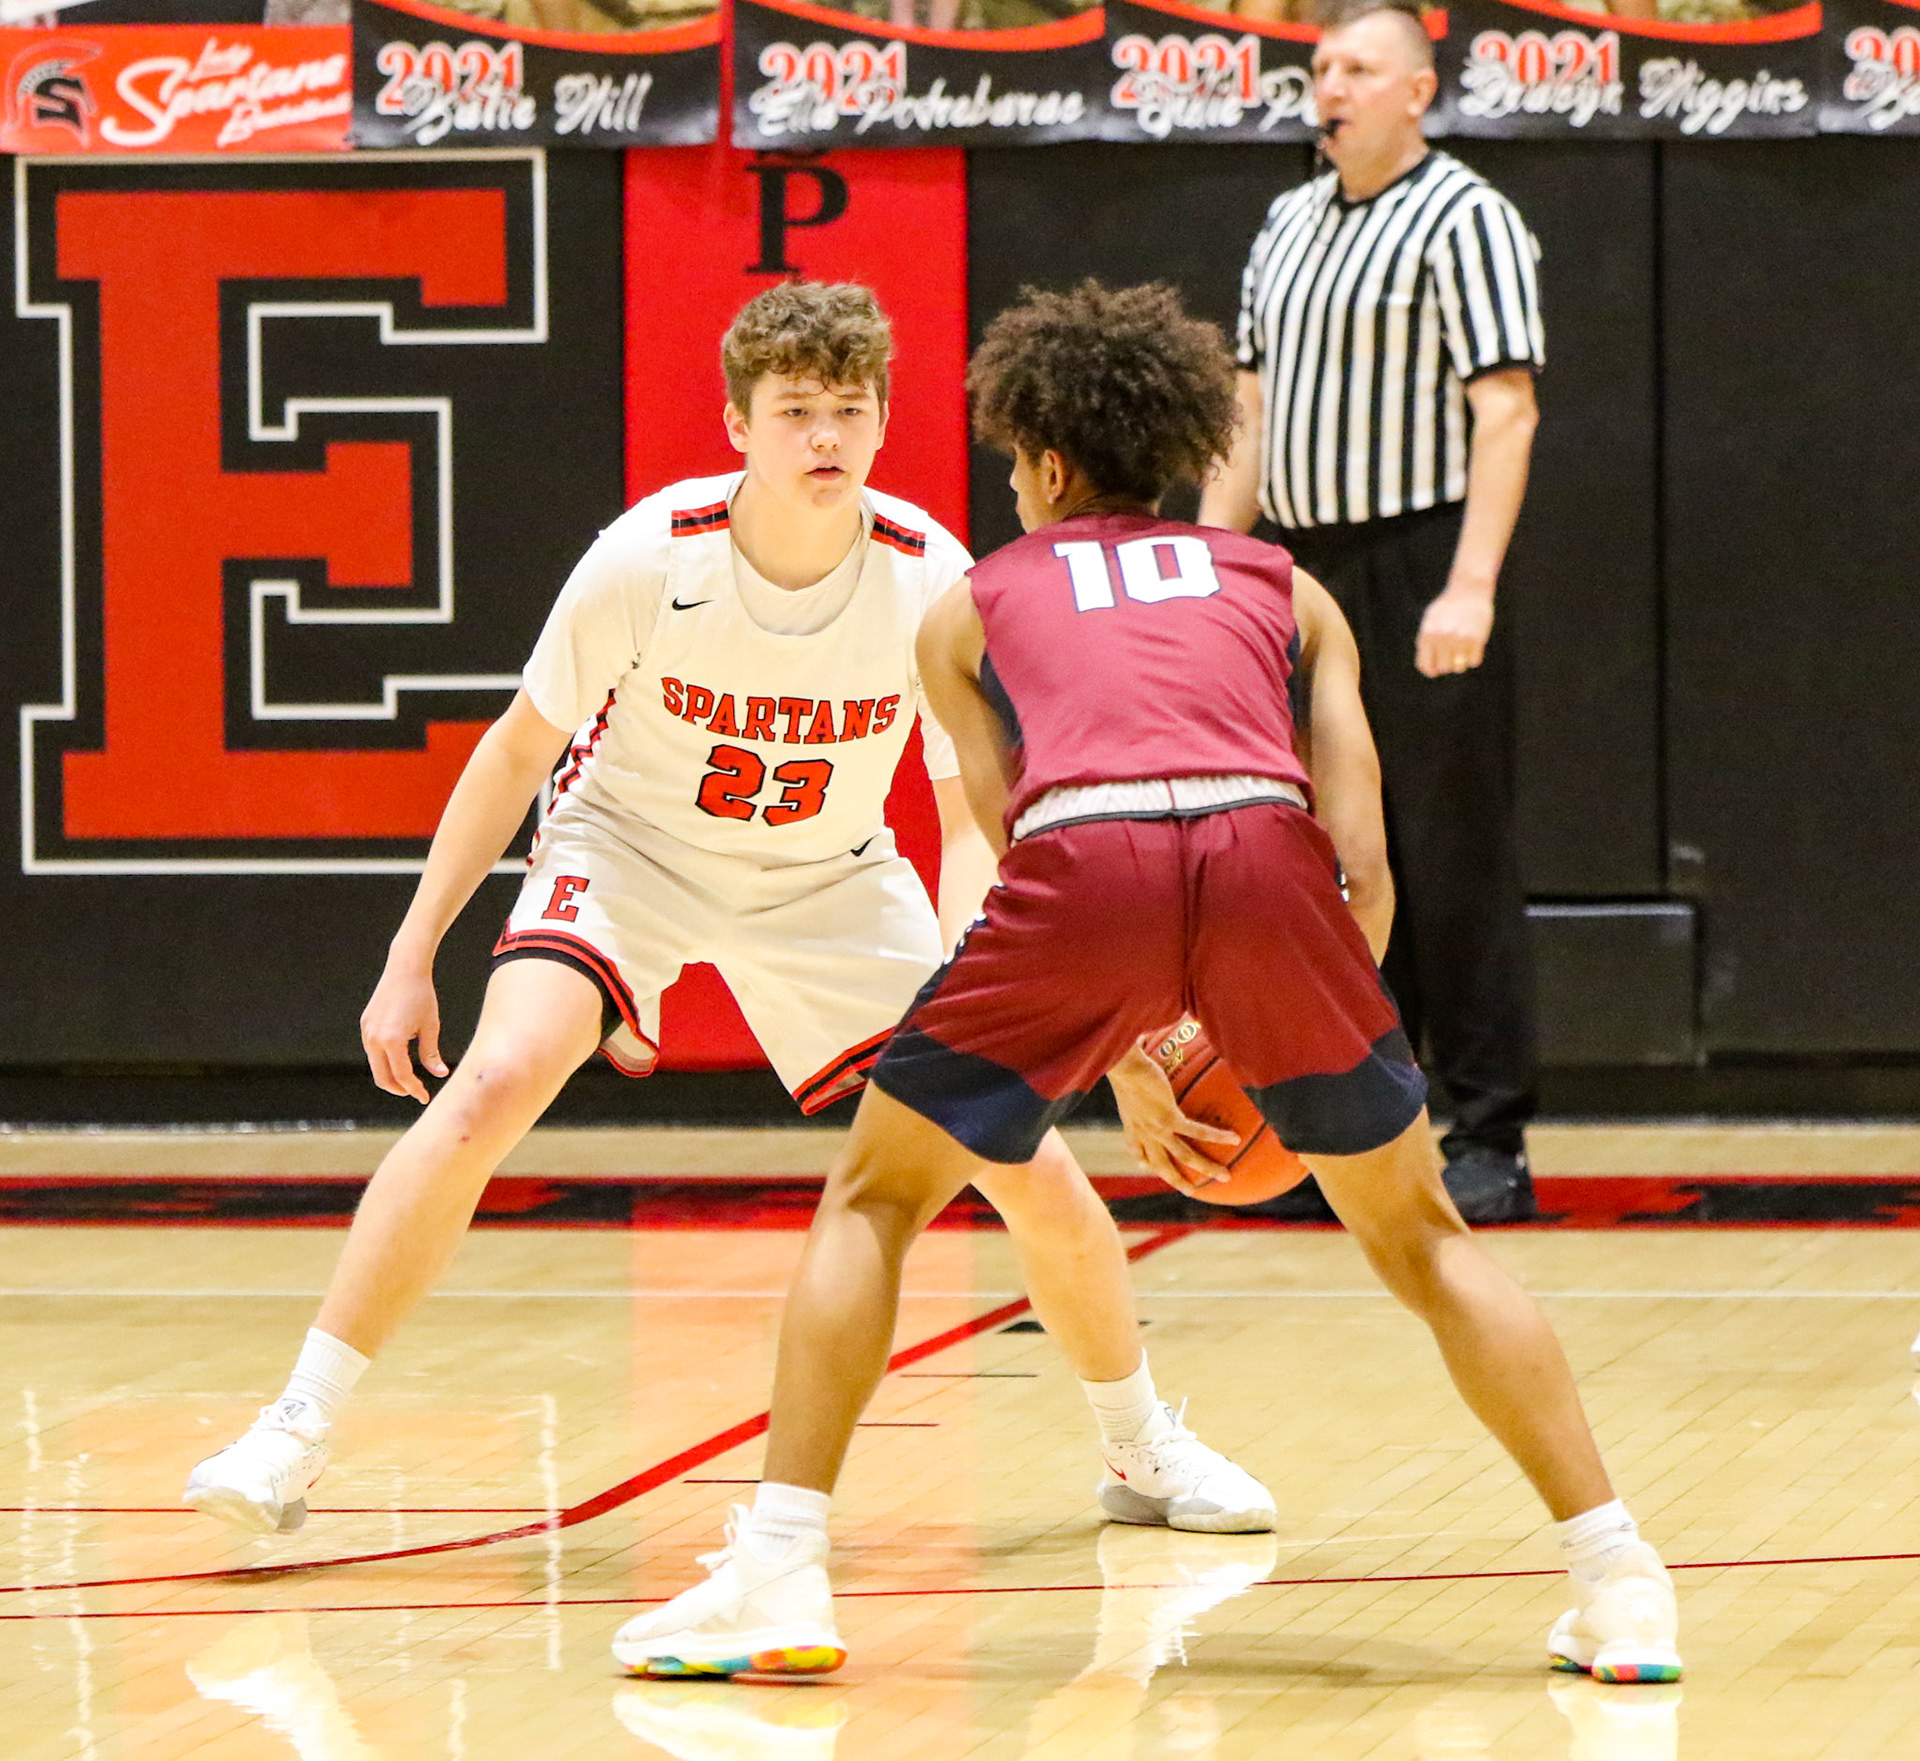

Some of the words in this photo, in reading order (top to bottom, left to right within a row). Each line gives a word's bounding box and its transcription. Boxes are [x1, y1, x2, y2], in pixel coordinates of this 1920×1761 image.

[375, 41, 524, 115] 2021
[759, 40, 907, 116] 2021
[1111, 34, 1262, 109] 2021
[1470, 29, 1621, 92] 2021
[100, 54, 348, 147] Spartans
[14, 148, 548, 875] E
[1052, 535, 1222, 613] 10
[661, 676, 901, 745] SPARTANS
[695, 743, 834, 827] 23
[540, 875, 591, 923] E
